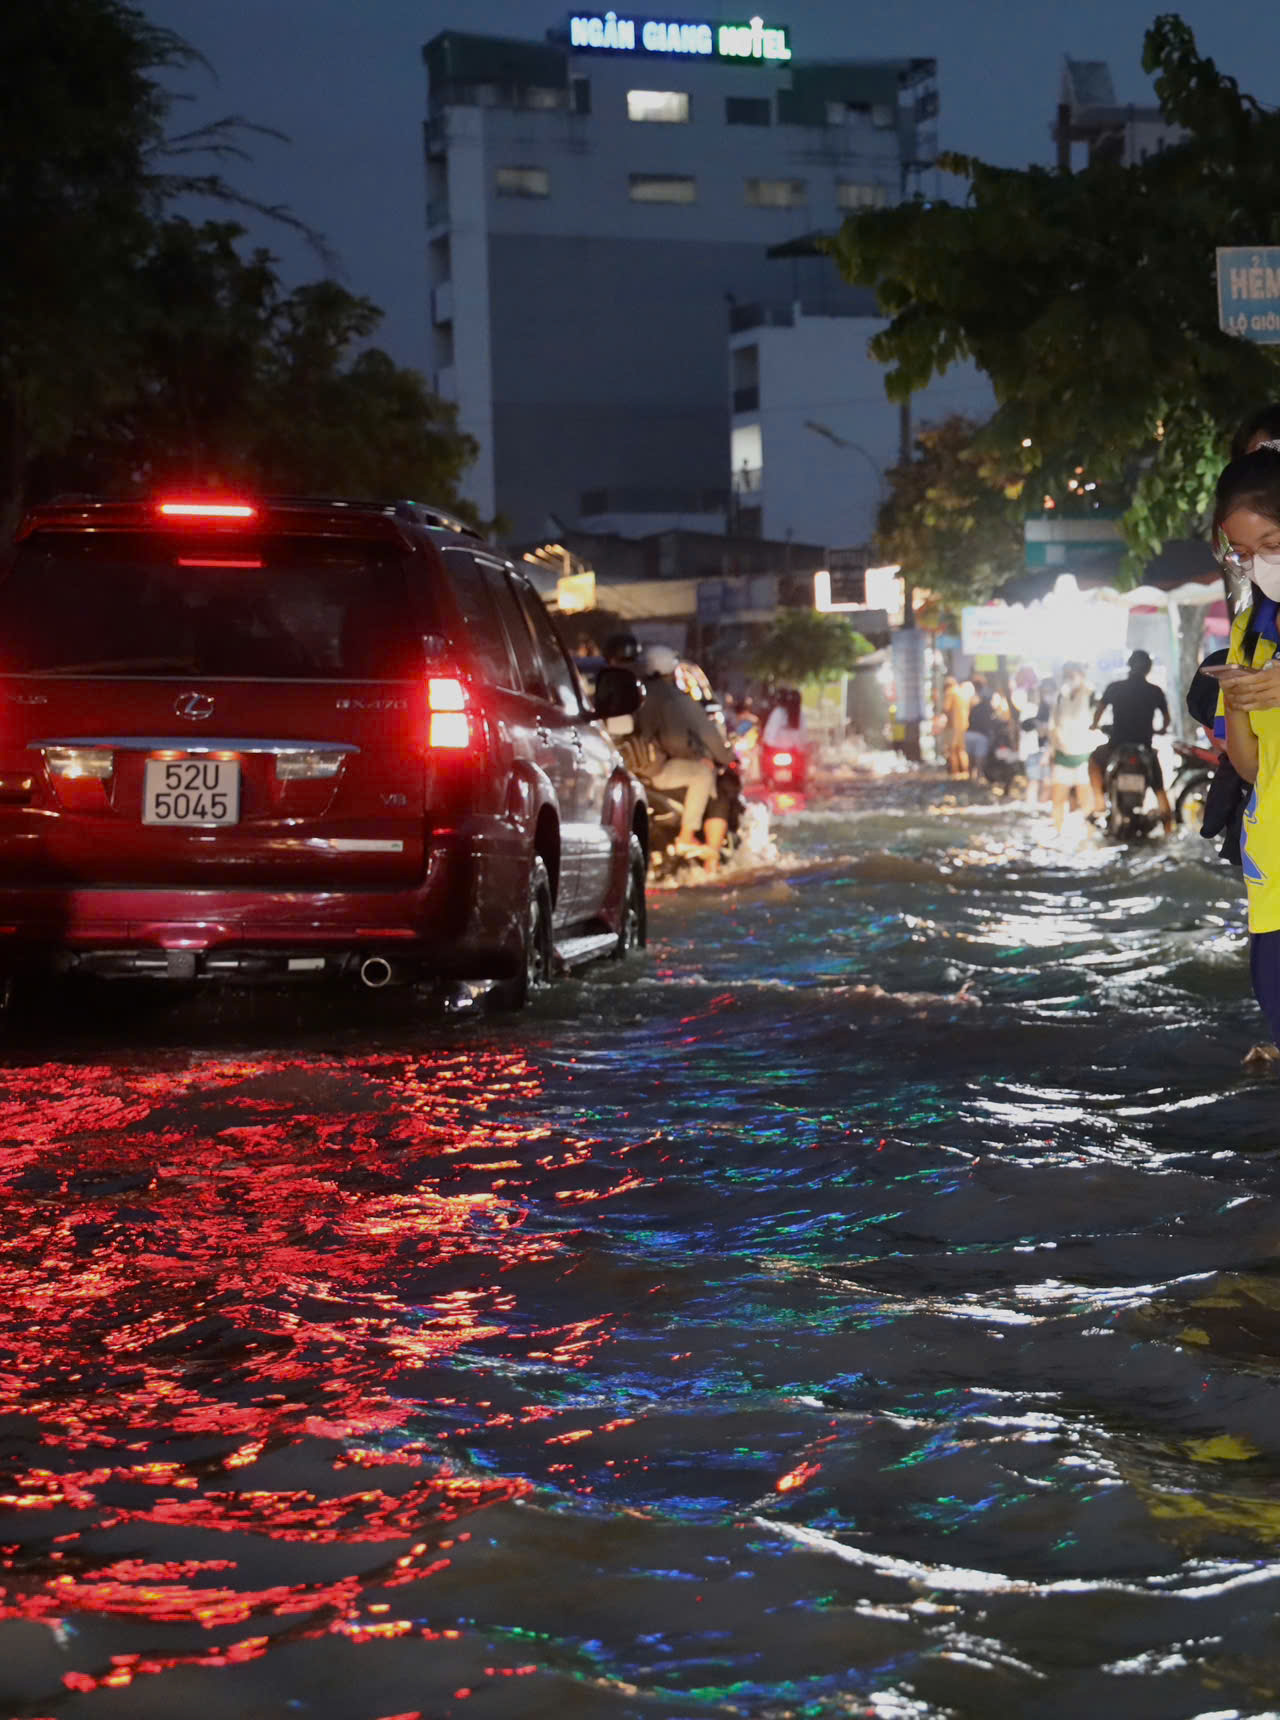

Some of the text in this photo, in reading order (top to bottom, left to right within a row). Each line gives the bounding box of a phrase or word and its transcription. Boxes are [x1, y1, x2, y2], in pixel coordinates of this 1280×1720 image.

[571, 11, 635, 50] NGÂN
[642, 21, 713, 55] GIANG
[165, 764, 220, 790] 52U
[154, 792, 228, 819] 5045
